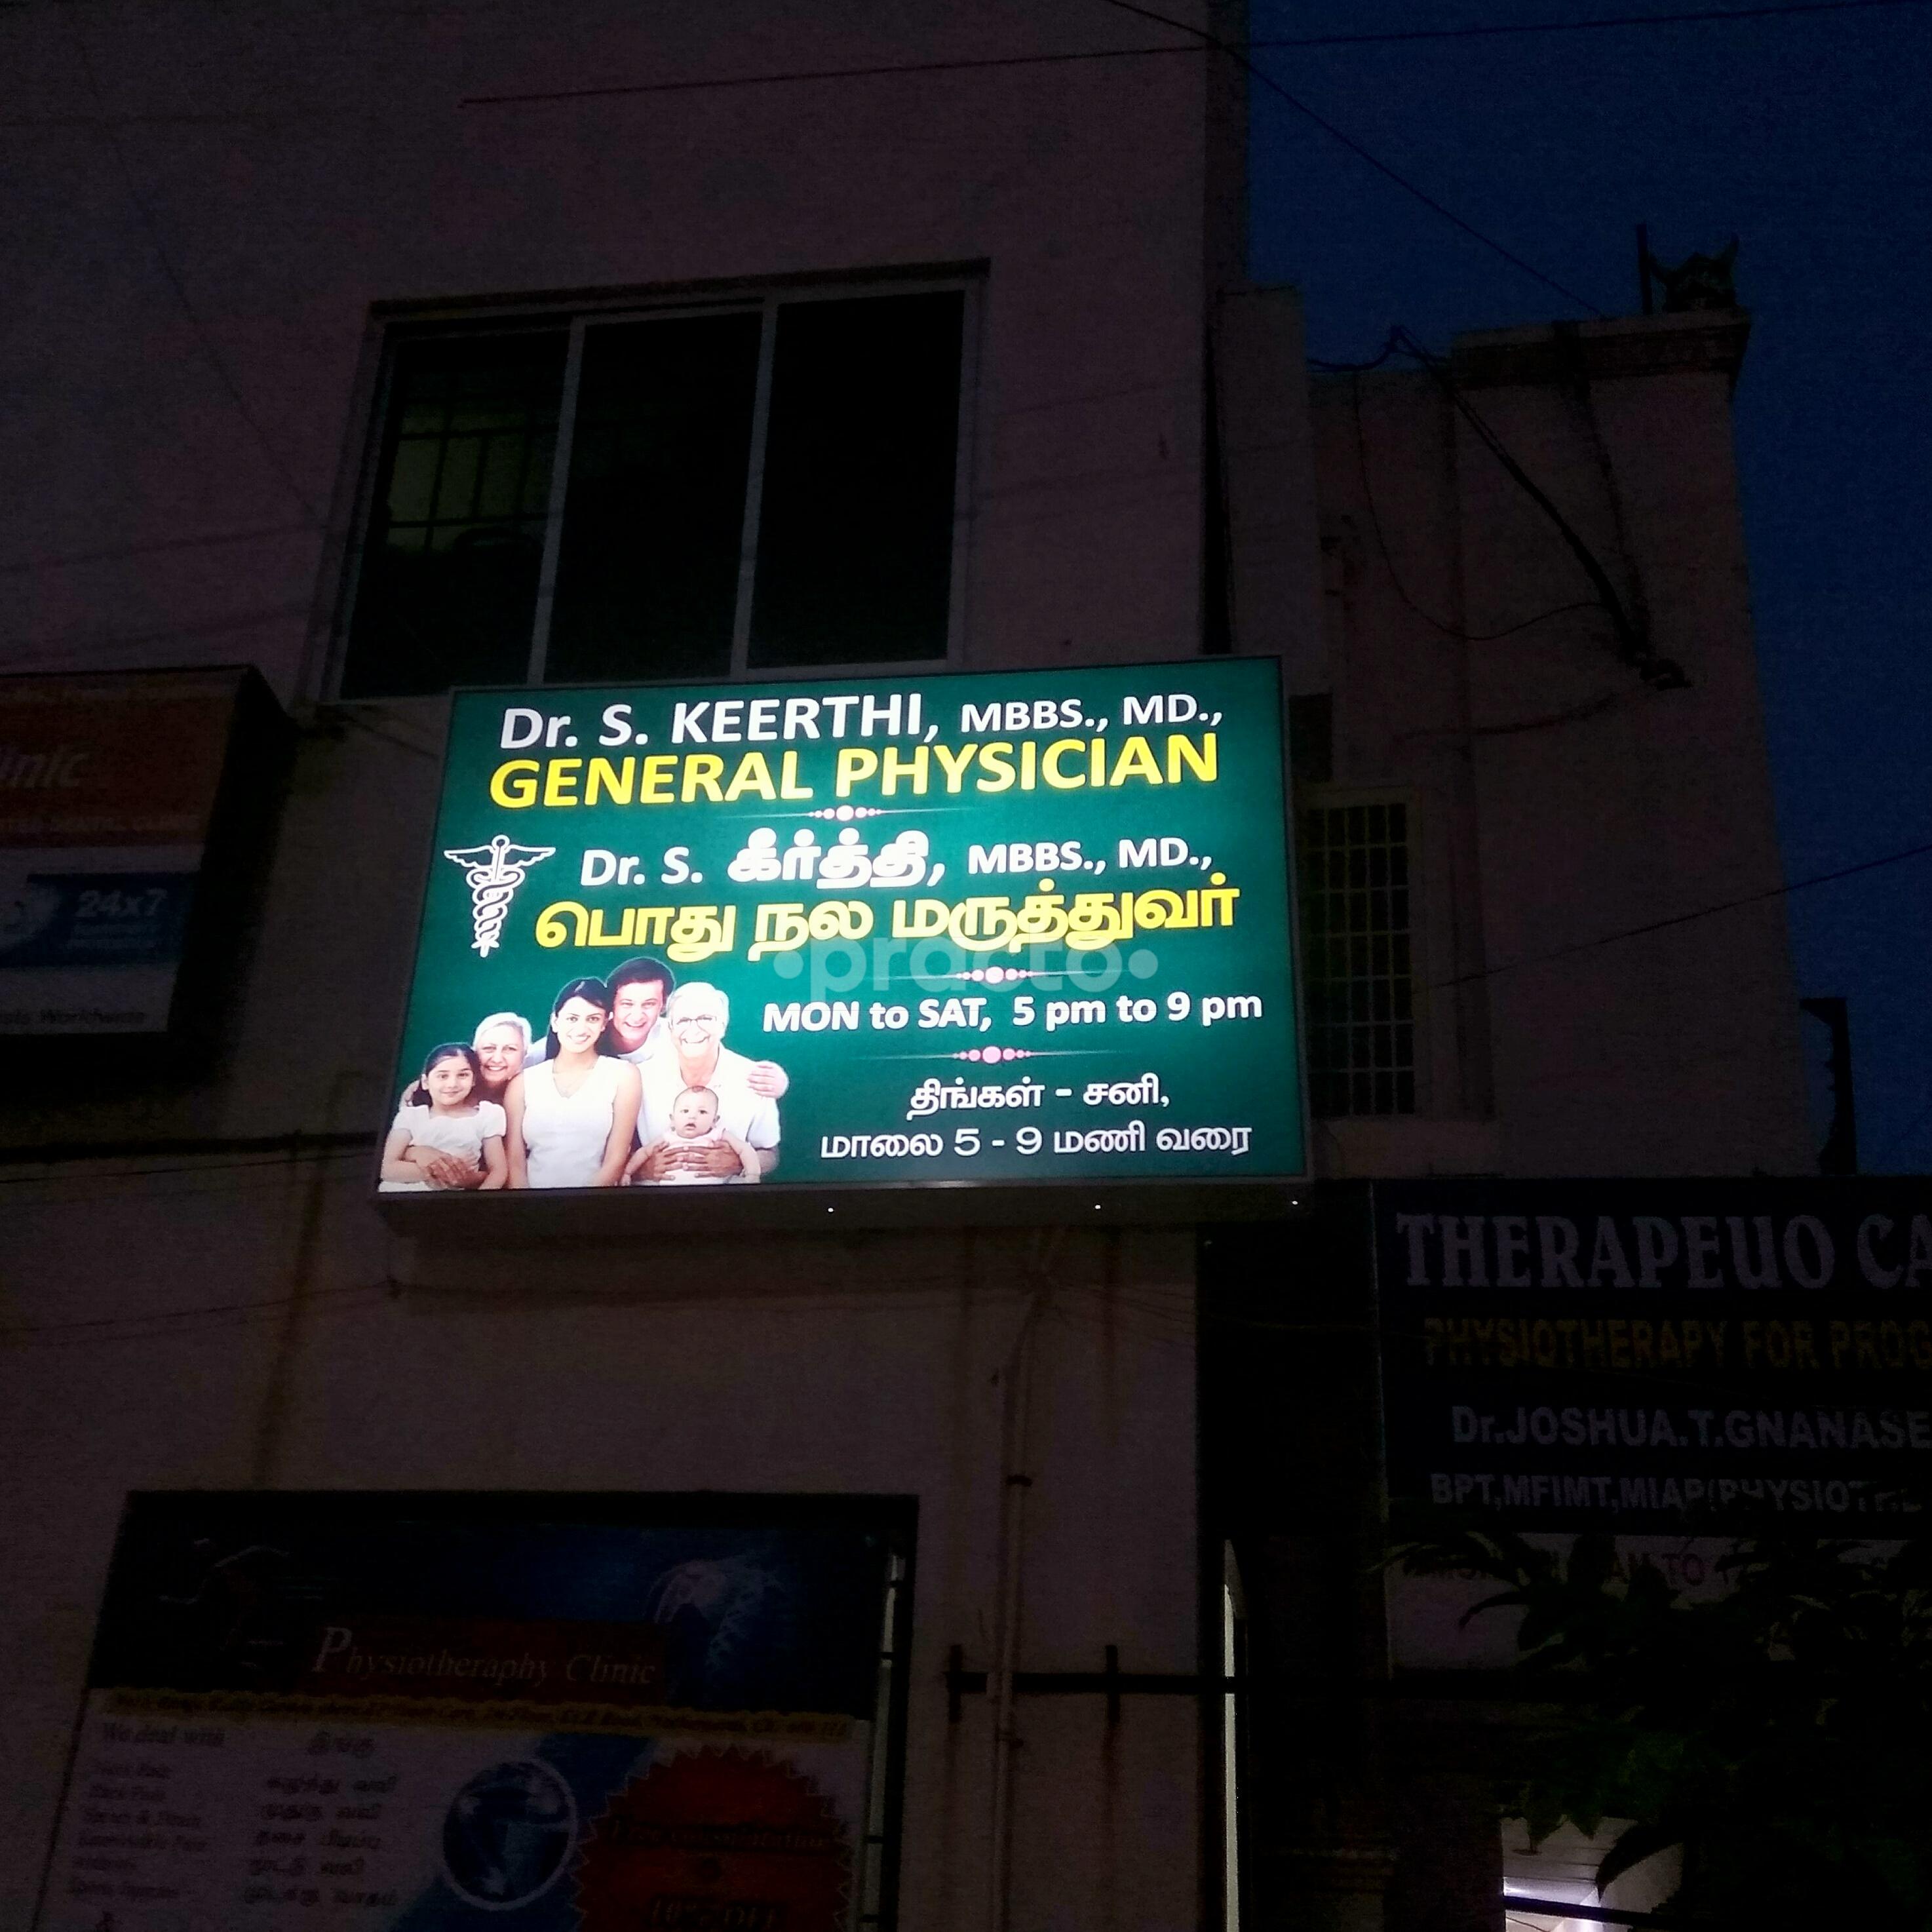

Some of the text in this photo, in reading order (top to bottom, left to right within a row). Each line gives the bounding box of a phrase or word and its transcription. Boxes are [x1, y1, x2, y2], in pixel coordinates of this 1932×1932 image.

[500, 693, 1223, 748] Dr. S. KEERTHI, MBBS., MD.,
[490, 732, 1218, 808] GENERAL PHYSICIAN
[580, 849, 646, 886] Dr.
[661, 846, 703, 885] S.
[968, 841, 1107, 875] MBBS.,
[1119, 837, 1212, 871] MD.,
[535, 872, 1241, 963] பொது நல மருத்துவர்
[763, 991, 1264, 1033] MON to SAT, 5 pm to 9 pm
[906, 1075, 1046, 1121] திங்கள்
[1083, 1072, 1170, 1108] சனி,
[820, 1131, 944, 1158] மாலை
[953, 1127, 981, 1156] 5
[1014, 1126, 1043, 1155] 9
[1053, 1119, 1146, 1153] மணி
[1155, 1125, 1253, 1155] வரை
[1396, 1212, 1836, 1289] THERAPEUO
[1423, 1317, 1932, 1372] PHYSIOTHERAPY FOR PROG
[565, 1652, 656, 1685] Clinic
